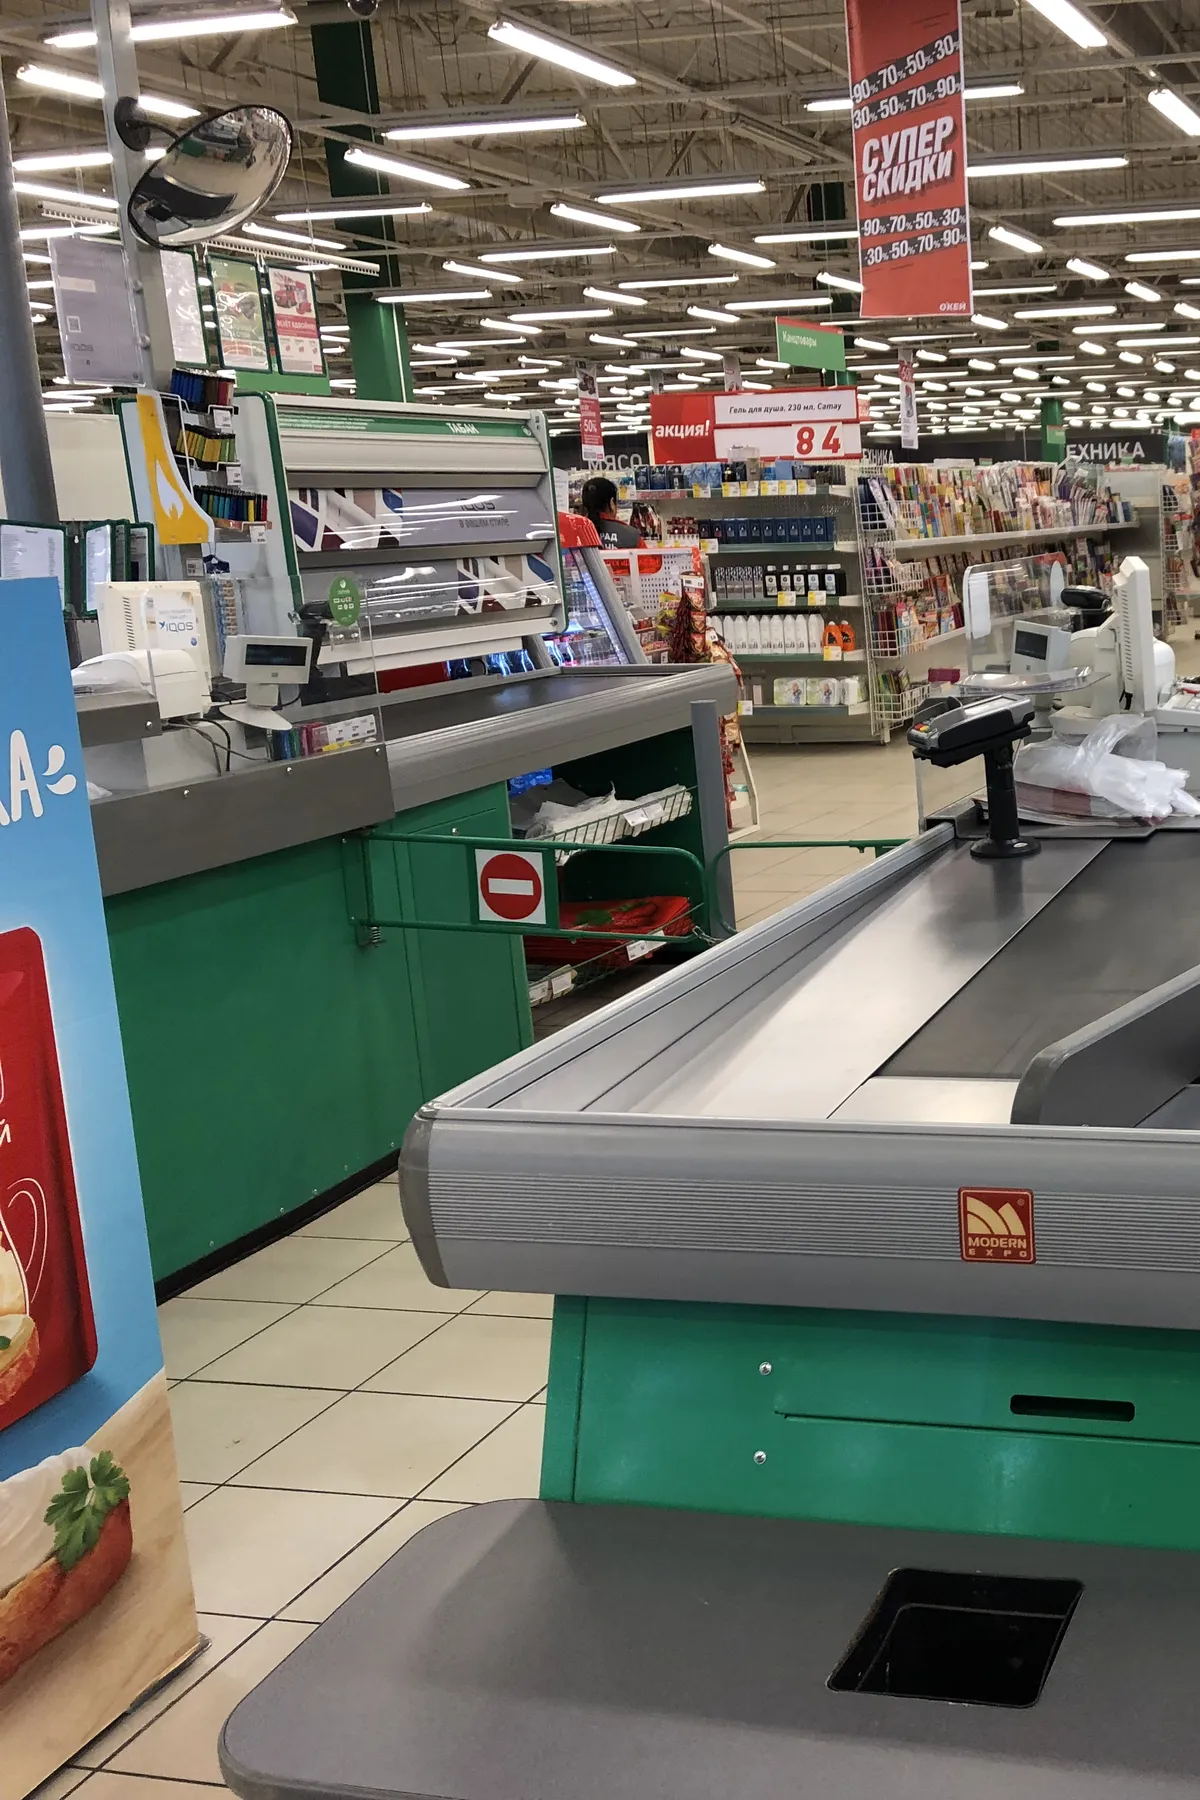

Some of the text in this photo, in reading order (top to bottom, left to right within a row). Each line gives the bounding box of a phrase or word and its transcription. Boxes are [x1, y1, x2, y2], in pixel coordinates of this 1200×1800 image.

[862, 115, 954, 174] СУПЕР
[863, 149, 953, 202] СКИДКИ
[729, 406, 747, 414] Гель
[748, 406, 762, 414] для
[788, 403, 802, 412] 230
[817, 402, 842, 411] Camay
[445, 422, 480, 434] ТАБАК
[655, 420, 710, 439] акция!
[1066, 441, 1146, 461] ЕХНИКА
[165, 621, 194, 633] IQOS
[968, 1237, 1027, 1249] MODERN
[968, 1247, 1027, 1258] EXPO
